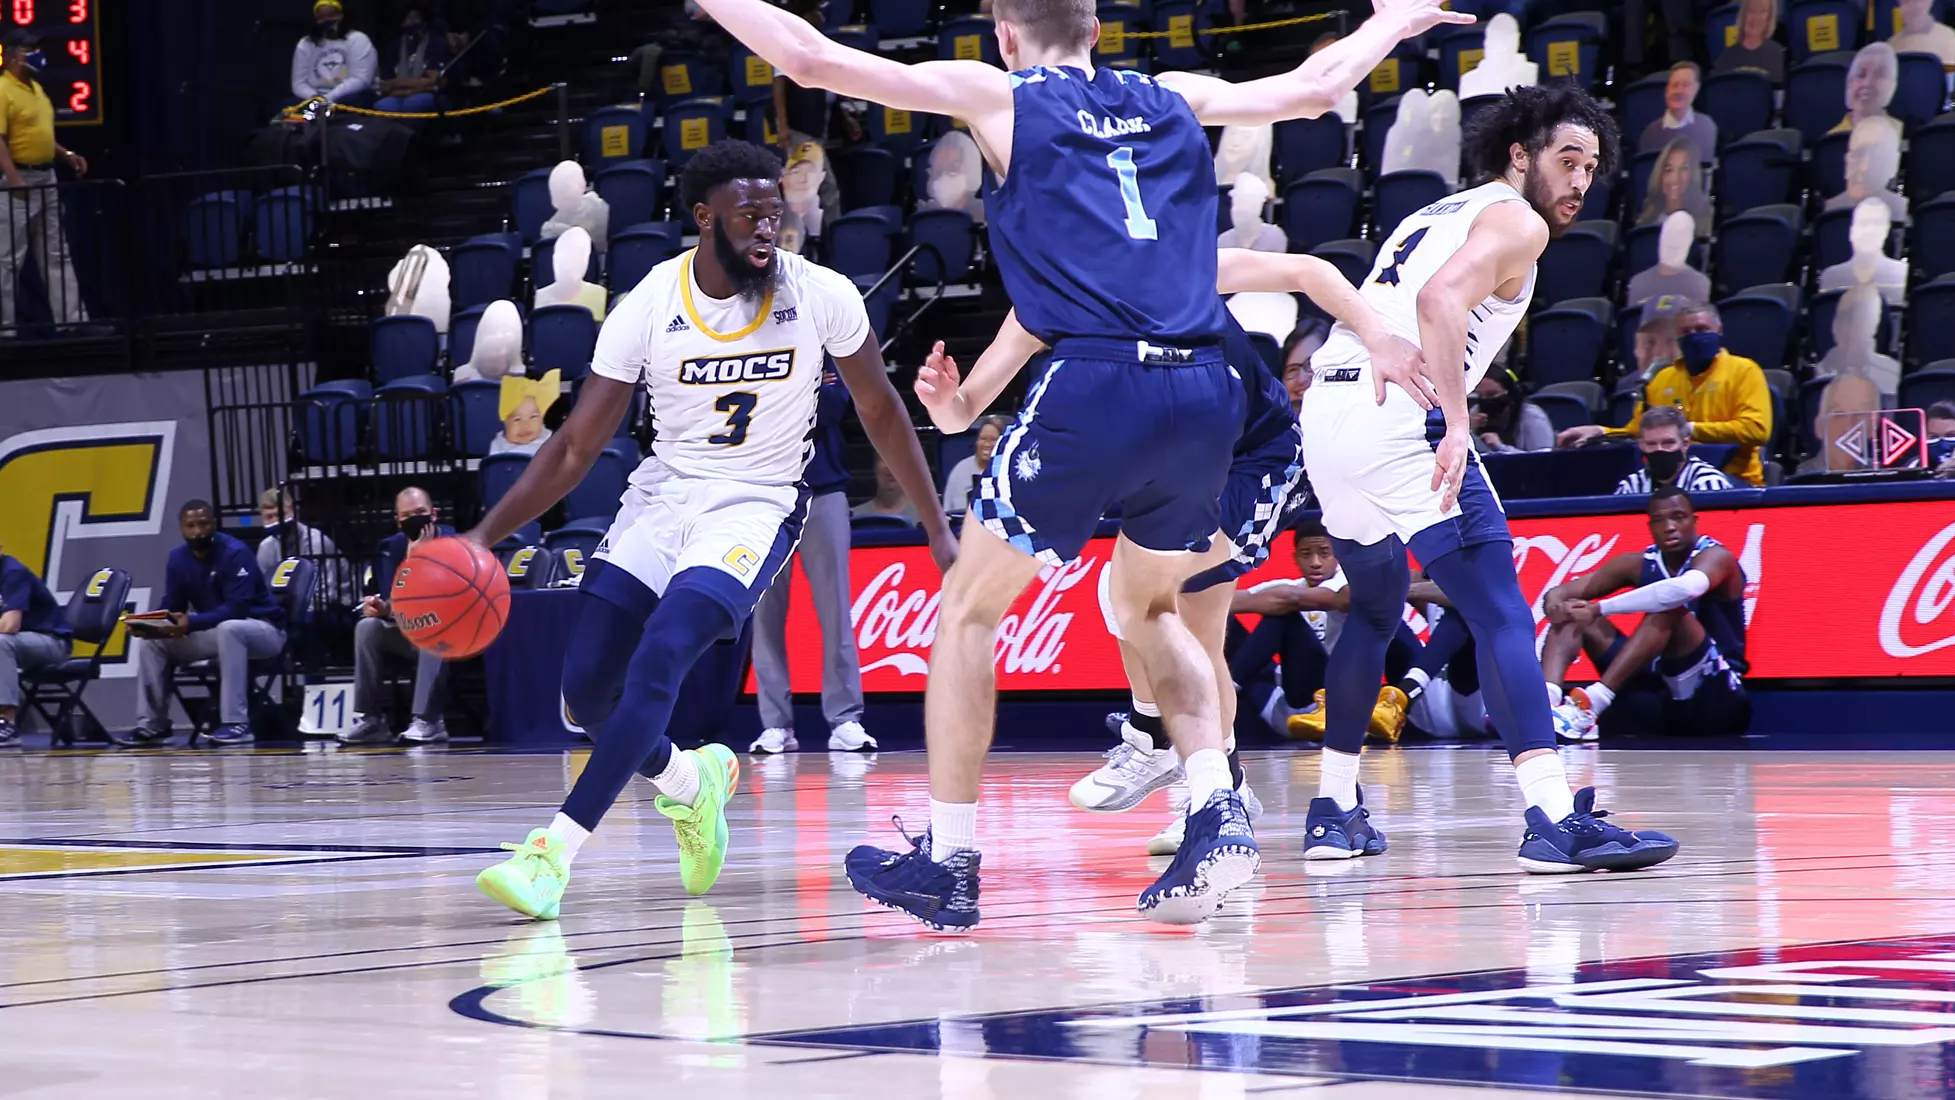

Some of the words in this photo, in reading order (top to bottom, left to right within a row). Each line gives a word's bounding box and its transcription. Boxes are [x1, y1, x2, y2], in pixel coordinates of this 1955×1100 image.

[68, 40, 90, 65] 4
[70, 81, 91, 112] 2
[1106, 146, 1158, 241] 1
[665, 324, 690, 333] adidas
[681, 352, 791, 383] MOCS
[708, 390, 759, 447] 3
[722, 544, 760, 576] C
[400, 611, 441, 631] lson
[312, 690, 345, 729] 11
